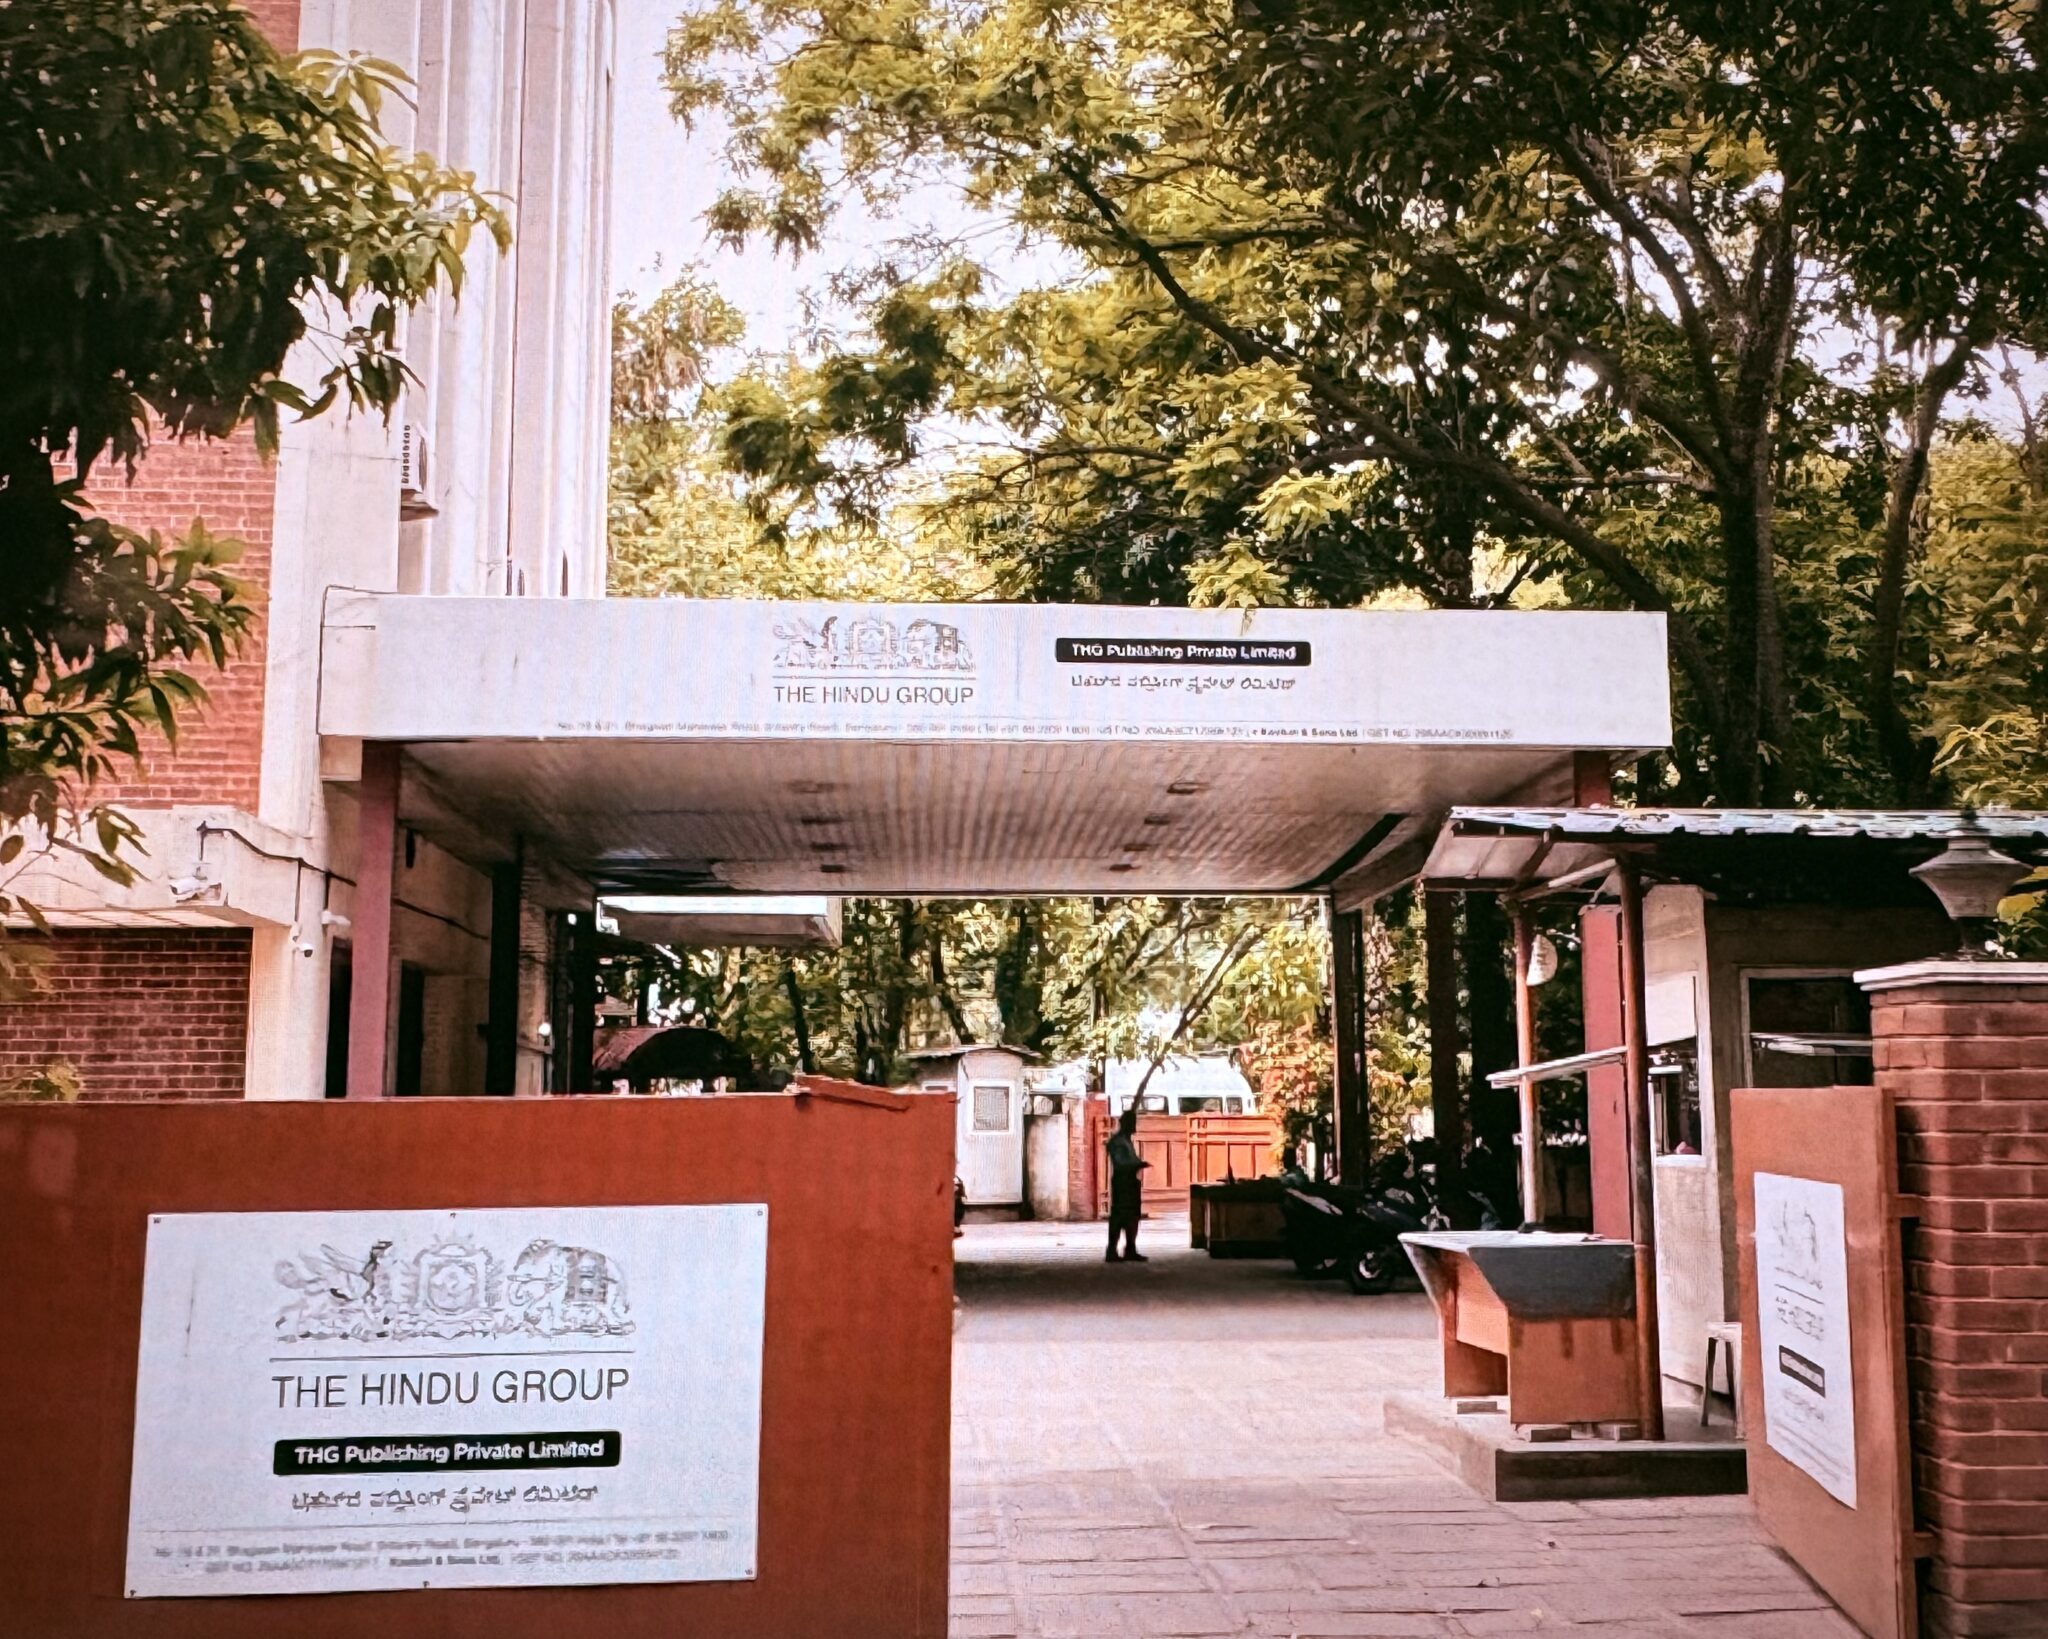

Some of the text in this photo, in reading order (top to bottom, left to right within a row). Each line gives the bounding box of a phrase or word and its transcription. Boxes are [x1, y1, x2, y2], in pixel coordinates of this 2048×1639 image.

[1072, 643, 1104, 657] THG
[1187, 645, 1236, 659] Private
[773, 686, 974, 705] THE HINDU GROUP
[271, 1367, 631, 1408] THE HINDU GROUP
[294, 1439, 605, 1465] THG Publishing Private Limited
